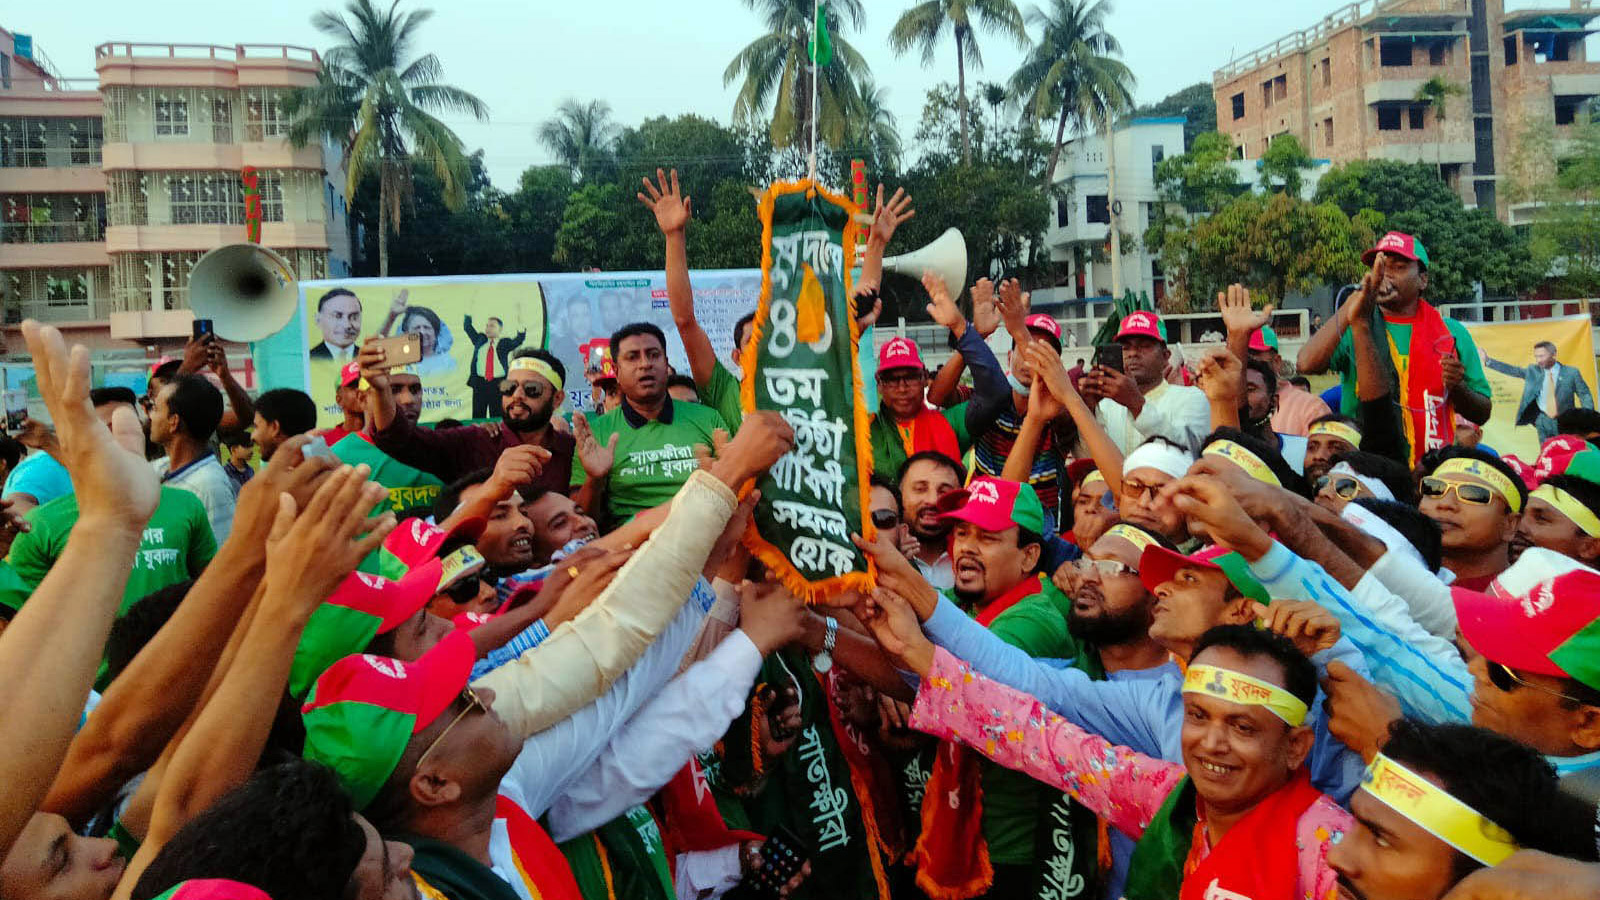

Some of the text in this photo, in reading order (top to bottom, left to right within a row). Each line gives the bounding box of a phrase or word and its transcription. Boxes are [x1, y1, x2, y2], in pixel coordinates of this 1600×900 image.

[762, 367, 829, 408] তম
[628, 443, 693, 466] সাতক্ষীরা
[780, 407, 848, 461] তিষ্ঠা
[772, 500, 849, 543] সফল
[790, 535, 855, 577] হোক
[798, 723, 849, 852] সাতক্ষীরা
